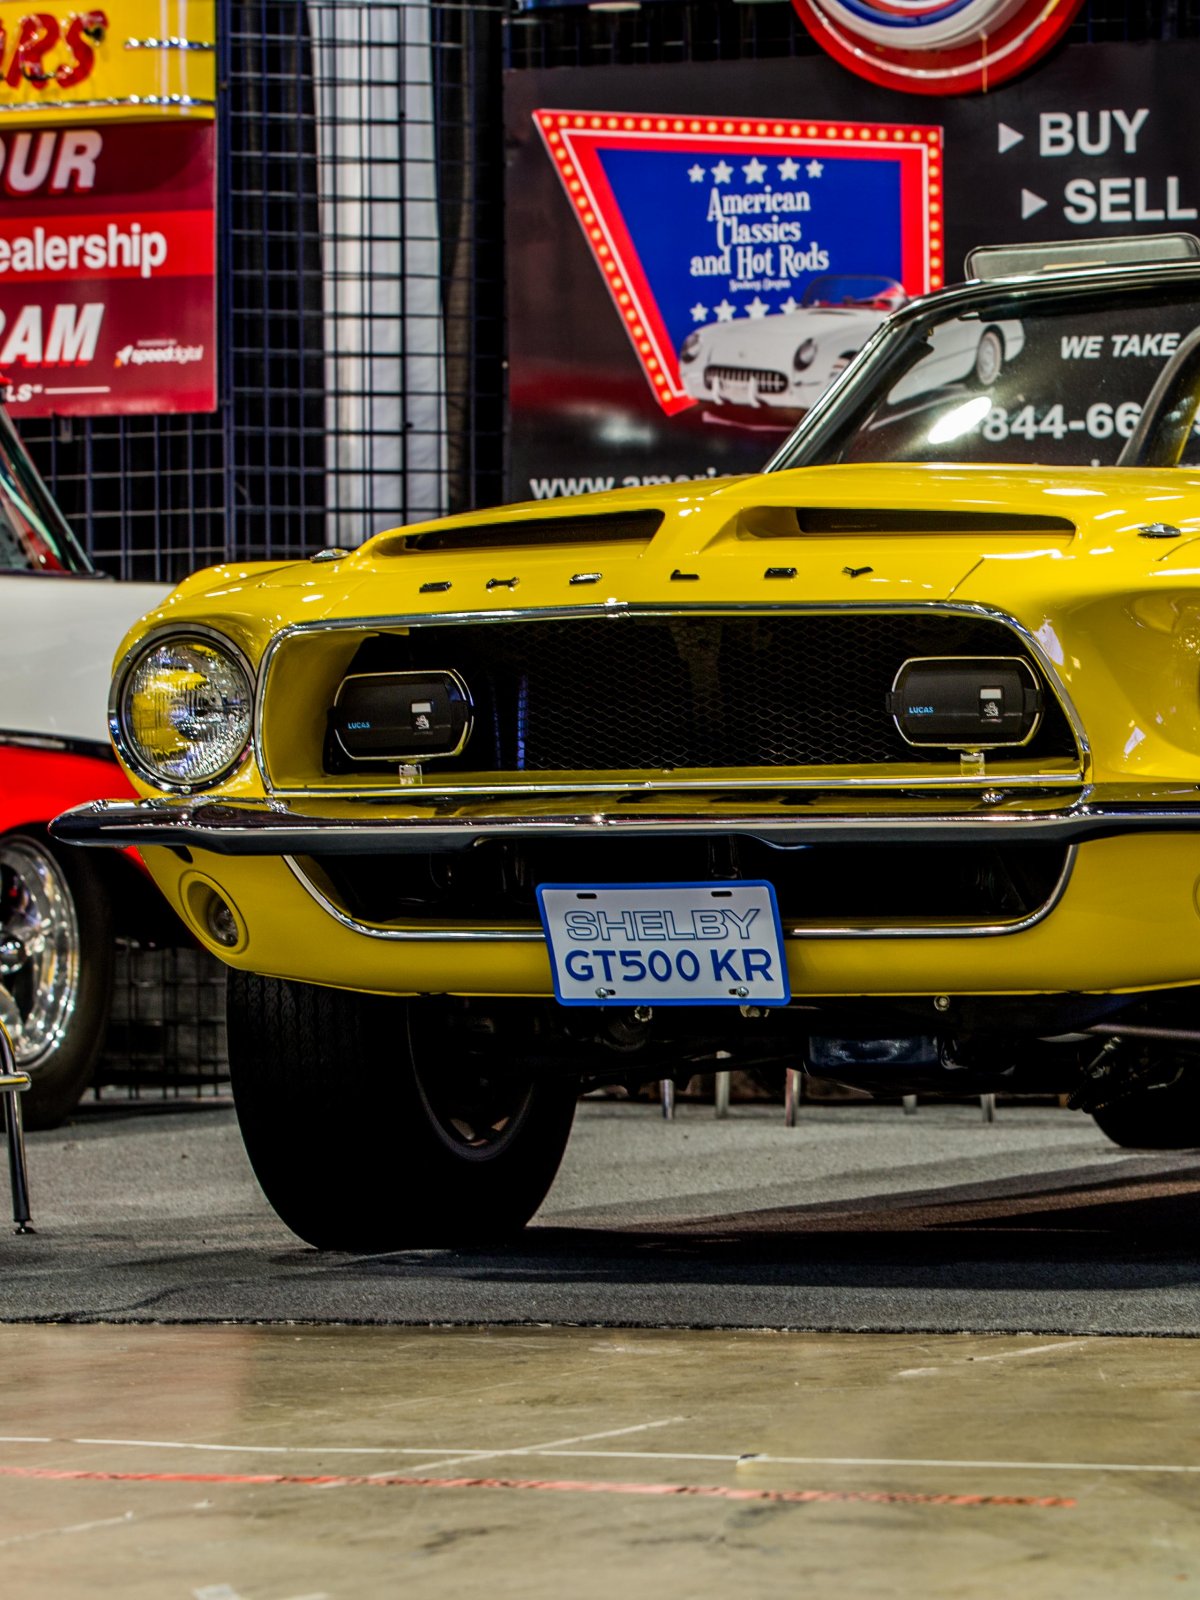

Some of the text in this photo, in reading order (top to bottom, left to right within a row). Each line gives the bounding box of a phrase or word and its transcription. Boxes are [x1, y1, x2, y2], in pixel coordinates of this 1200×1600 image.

[0, 10, 108, 90] RS
[1039, 109, 1149, 157] BUY
[0, 129, 103, 192] UR
[707, 184, 811, 222] American
[1063, 177, 1198, 224] SELL
[716, 214, 801, 250] Classics
[690, 241, 830, 280] and Hot Rods
[0, 303, 105, 364] AM
[1061, 332, 1182, 360] WE TAKE
[347, 721, 371, 730] LUCAS
[908, 706, 934, 714] LUCAS
[564, 907, 761, 942] SHELBY
[565, 948, 775, 982] GT500 KR
